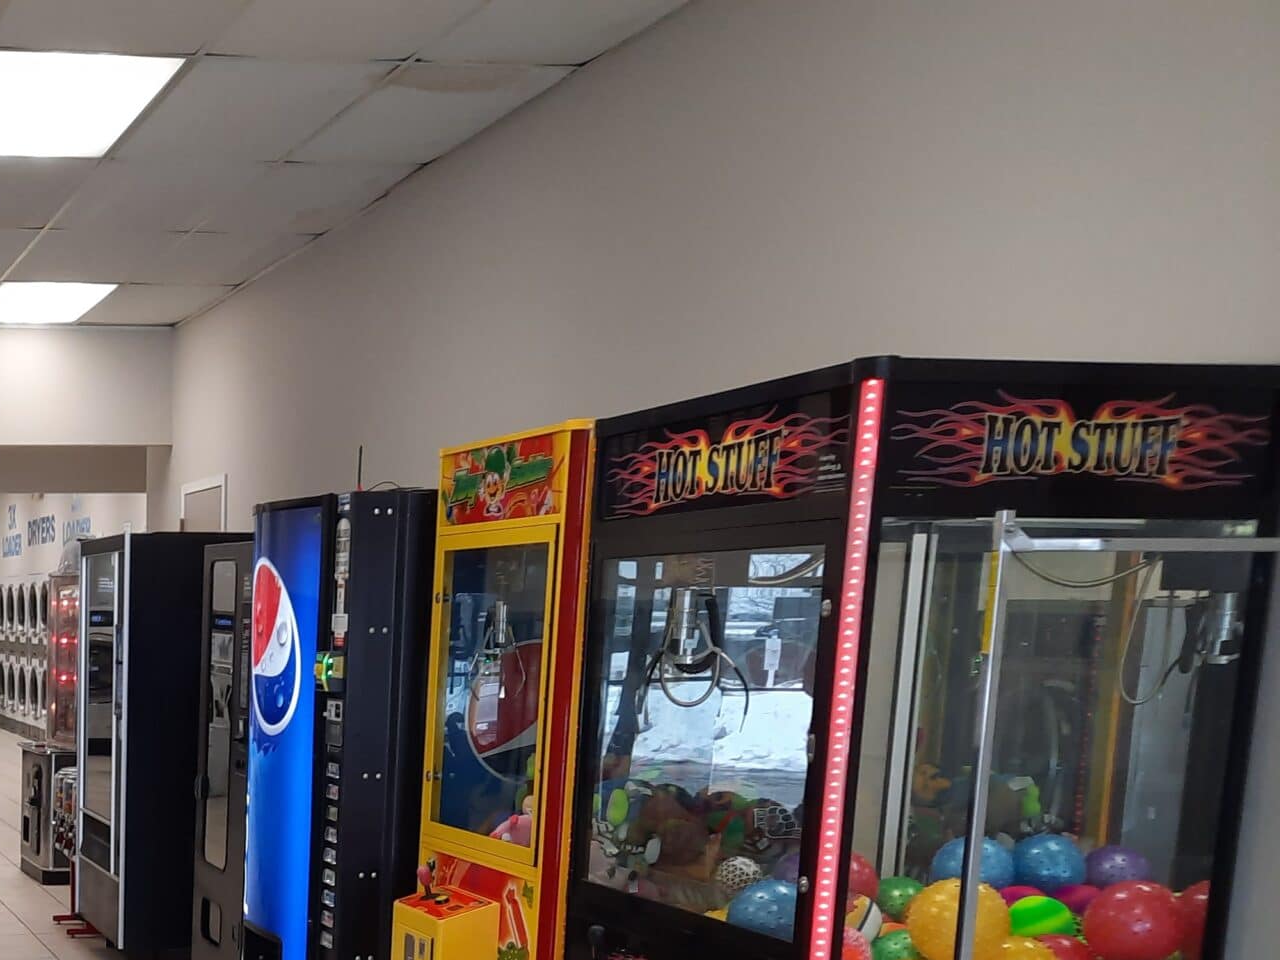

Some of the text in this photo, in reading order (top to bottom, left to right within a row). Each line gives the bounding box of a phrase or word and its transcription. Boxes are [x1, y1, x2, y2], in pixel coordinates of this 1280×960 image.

[653, 448, 703, 503] HOT
[704, 426, 786, 495] STUFF
[980, 413, 1182, 478] HOT STUFF
[27, 514, 56, 546] DRYERS
